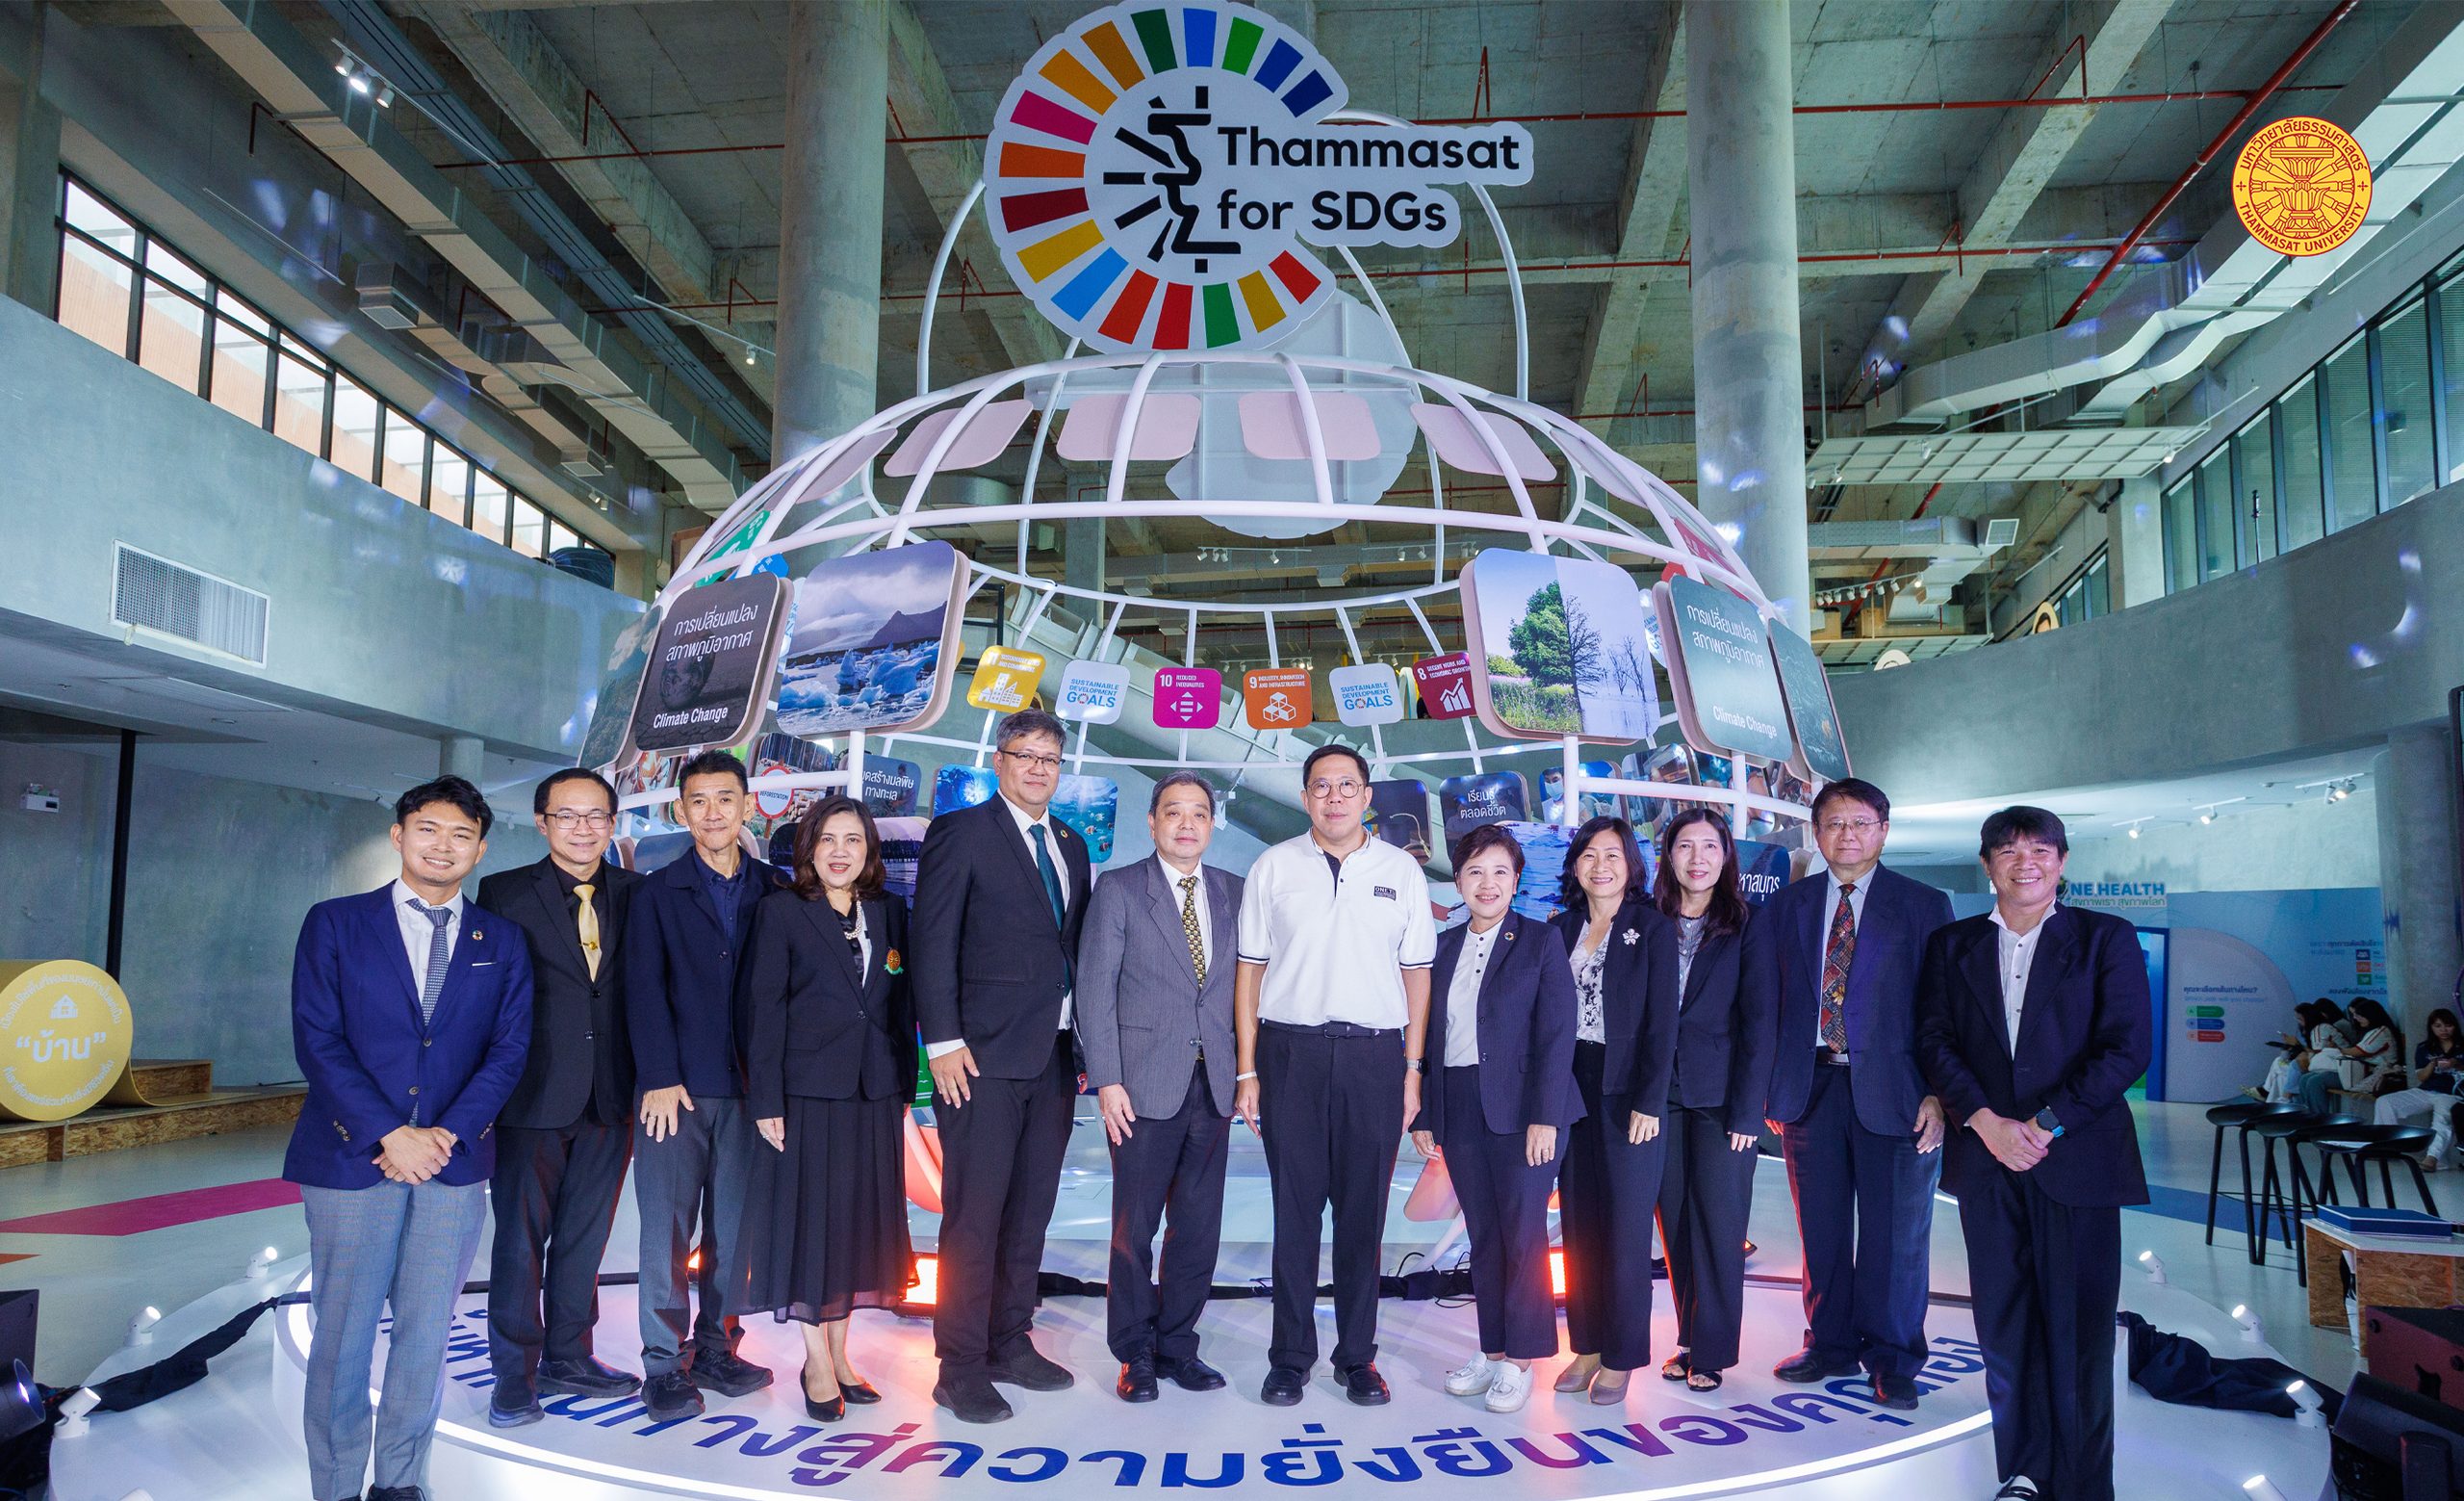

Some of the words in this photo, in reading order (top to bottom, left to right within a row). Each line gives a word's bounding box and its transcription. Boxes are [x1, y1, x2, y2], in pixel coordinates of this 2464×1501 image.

[1218, 126, 1520, 170] Thammasat
[1218, 190, 1294, 231] for
[1311, 190, 1447, 232] SDGs
[674, 603, 758, 636] การเปลี่ยนแปลง
[1686, 605, 1758, 644] การเปลี่ยนแปลง
[666, 630, 754, 662] สภาพภูมิอากาศ
[1692, 631, 1766, 670] สภาพภูมิอากาศ
[1159, 674, 1173, 687] 10
[1248, 676, 1258, 689] 9
[1417, 667, 1427, 681] 8
[1068, 685, 1118, 697] DEVELOPMENT
[1070, 678, 1119, 690] SUSTAINABLE
[1340, 682, 1389, 693] SUSTAINABLE
[1066, 691, 1116, 708] GOALS
[1342, 688, 1390, 699] DEVELOPMENT
[1344, 695, 1394, 711] GOALS
[653, 711, 689, 729] Climate
[690, 707, 729, 726] Change
[1712, 705, 1746, 729] Climate
[1746, 715, 1778, 739] Change
[865, 786, 898, 801] ทางทะเล
[1467, 788, 1496, 805] เรียนรู้
[1460, 802, 1507, 819] ตลอดชีวิต
[1737, 872, 1781, 902] หาสมุทร
[2098, 882, 2165, 896] HEALTH
[16, 1028, 107, 1063] “บ้าน”
